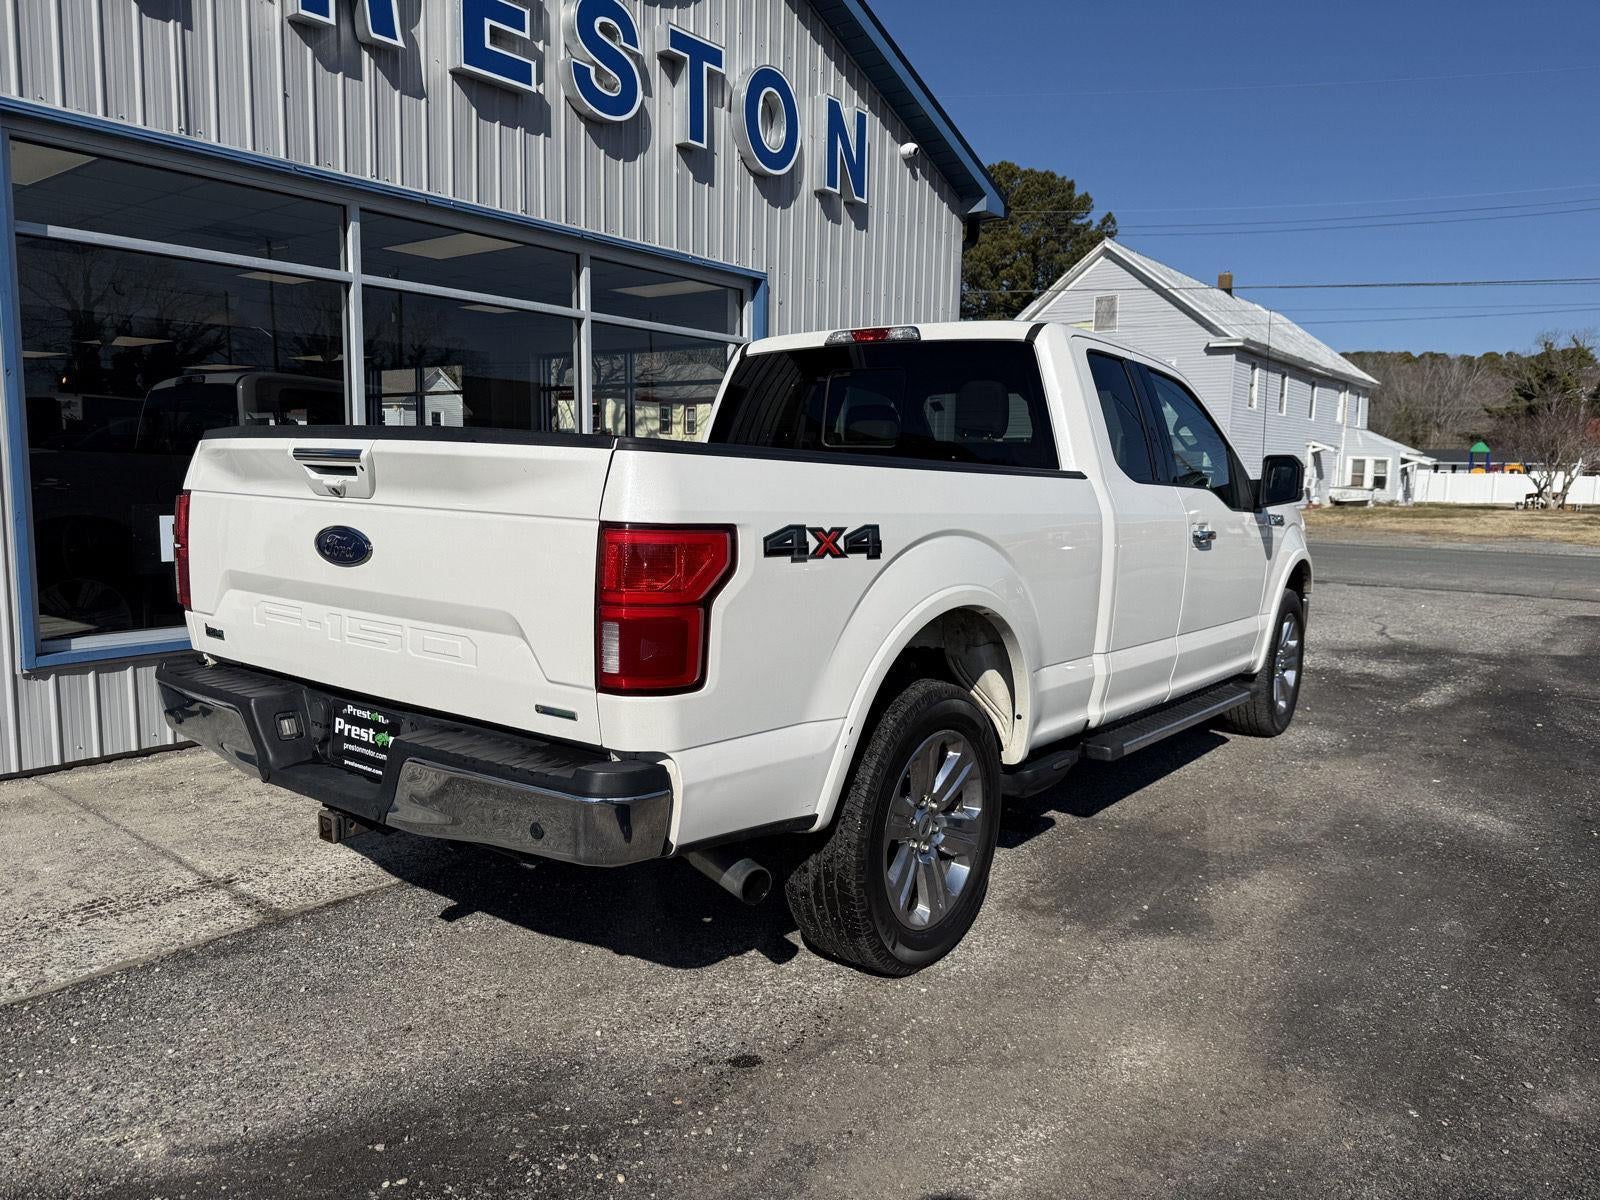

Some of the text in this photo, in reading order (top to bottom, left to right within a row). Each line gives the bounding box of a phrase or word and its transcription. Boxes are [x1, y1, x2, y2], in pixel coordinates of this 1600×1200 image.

[287, 0, 868, 204] ESTON
[324, 533, 359, 558] Ford
[253, 600, 478, 668] F-150
[343, 742, 388, 761] prestonmotor.com
